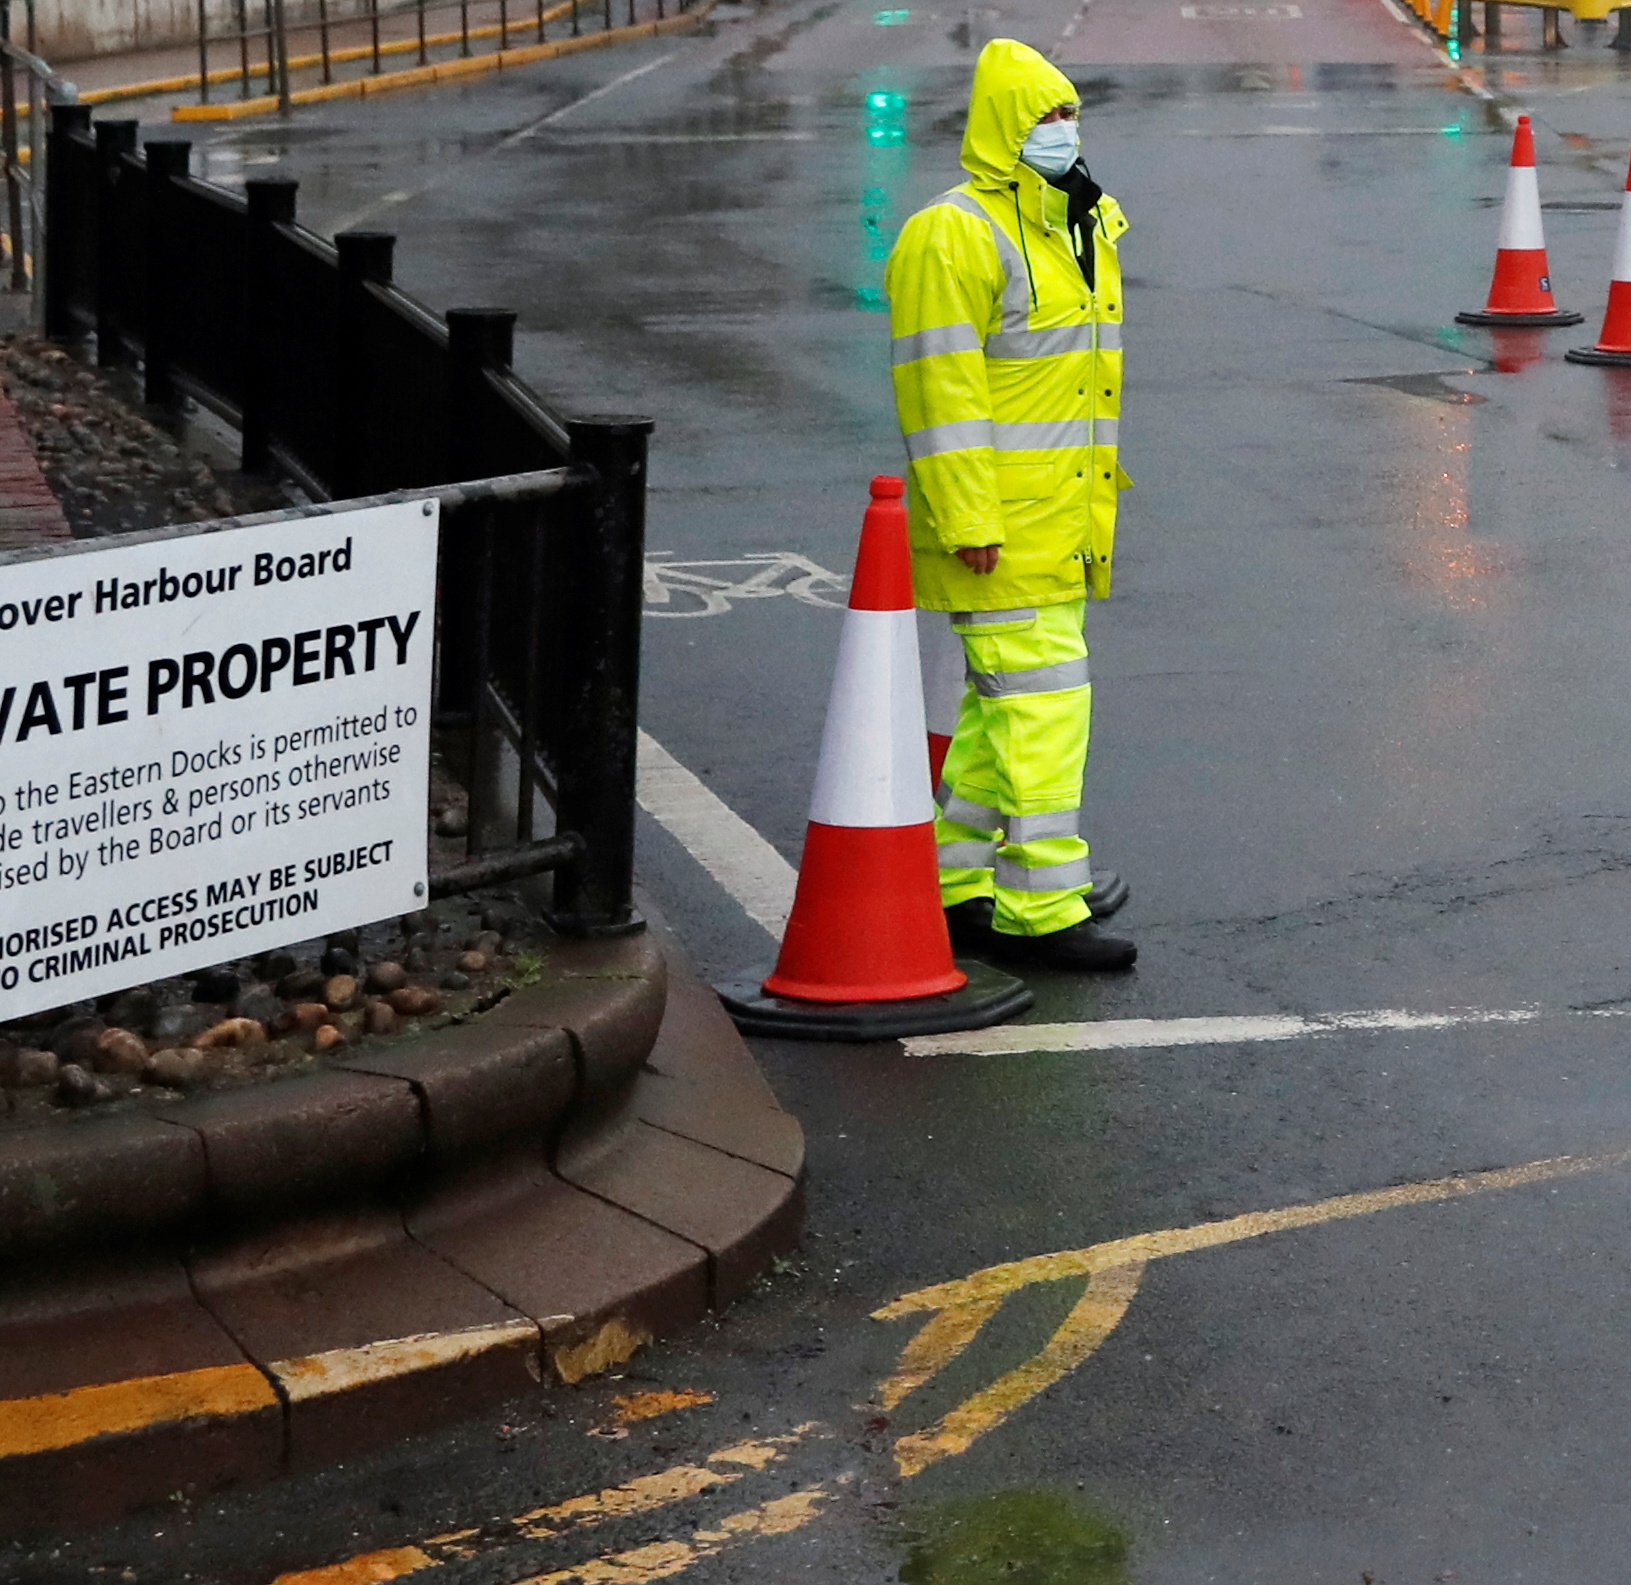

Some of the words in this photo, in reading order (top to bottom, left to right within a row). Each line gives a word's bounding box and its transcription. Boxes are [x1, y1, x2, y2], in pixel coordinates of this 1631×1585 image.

[95, 565, 243, 614] Harbour
[253, 536, 353, 586] Board
[147, 610, 422, 716] PROPERTY
[15, 780, 59, 811] the
[69, 761, 162, 800] Eastern
[172, 740, 242, 777] Docks
[250, 734, 266, 761] is
[274, 705, 388, 763] permitted
[394, 705, 418, 729] to
[32, 799, 153, 846] travellers
[162, 788, 180, 816] &
[189, 769, 281, 817] persons
[288, 742, 401, 787] otherwise
[59, 848, 89, 881] by
[97, 836, 140, 866] the
[150, 811, 222, 855] Board
[231, 810, 257, 835] or
[265, 801, 291, 828] its
[298, 778, 391, 819] servants
[28, 933, 152, 984] CRIMINAL
[159, 889, 319, 950] PROSECUTION
[106, 889, 199, 934] ACCESS
[206, 873, 262, 908] MAY
[269, 865, 297, 892] BE
[304, 840, 394, 884] SUBJECT
